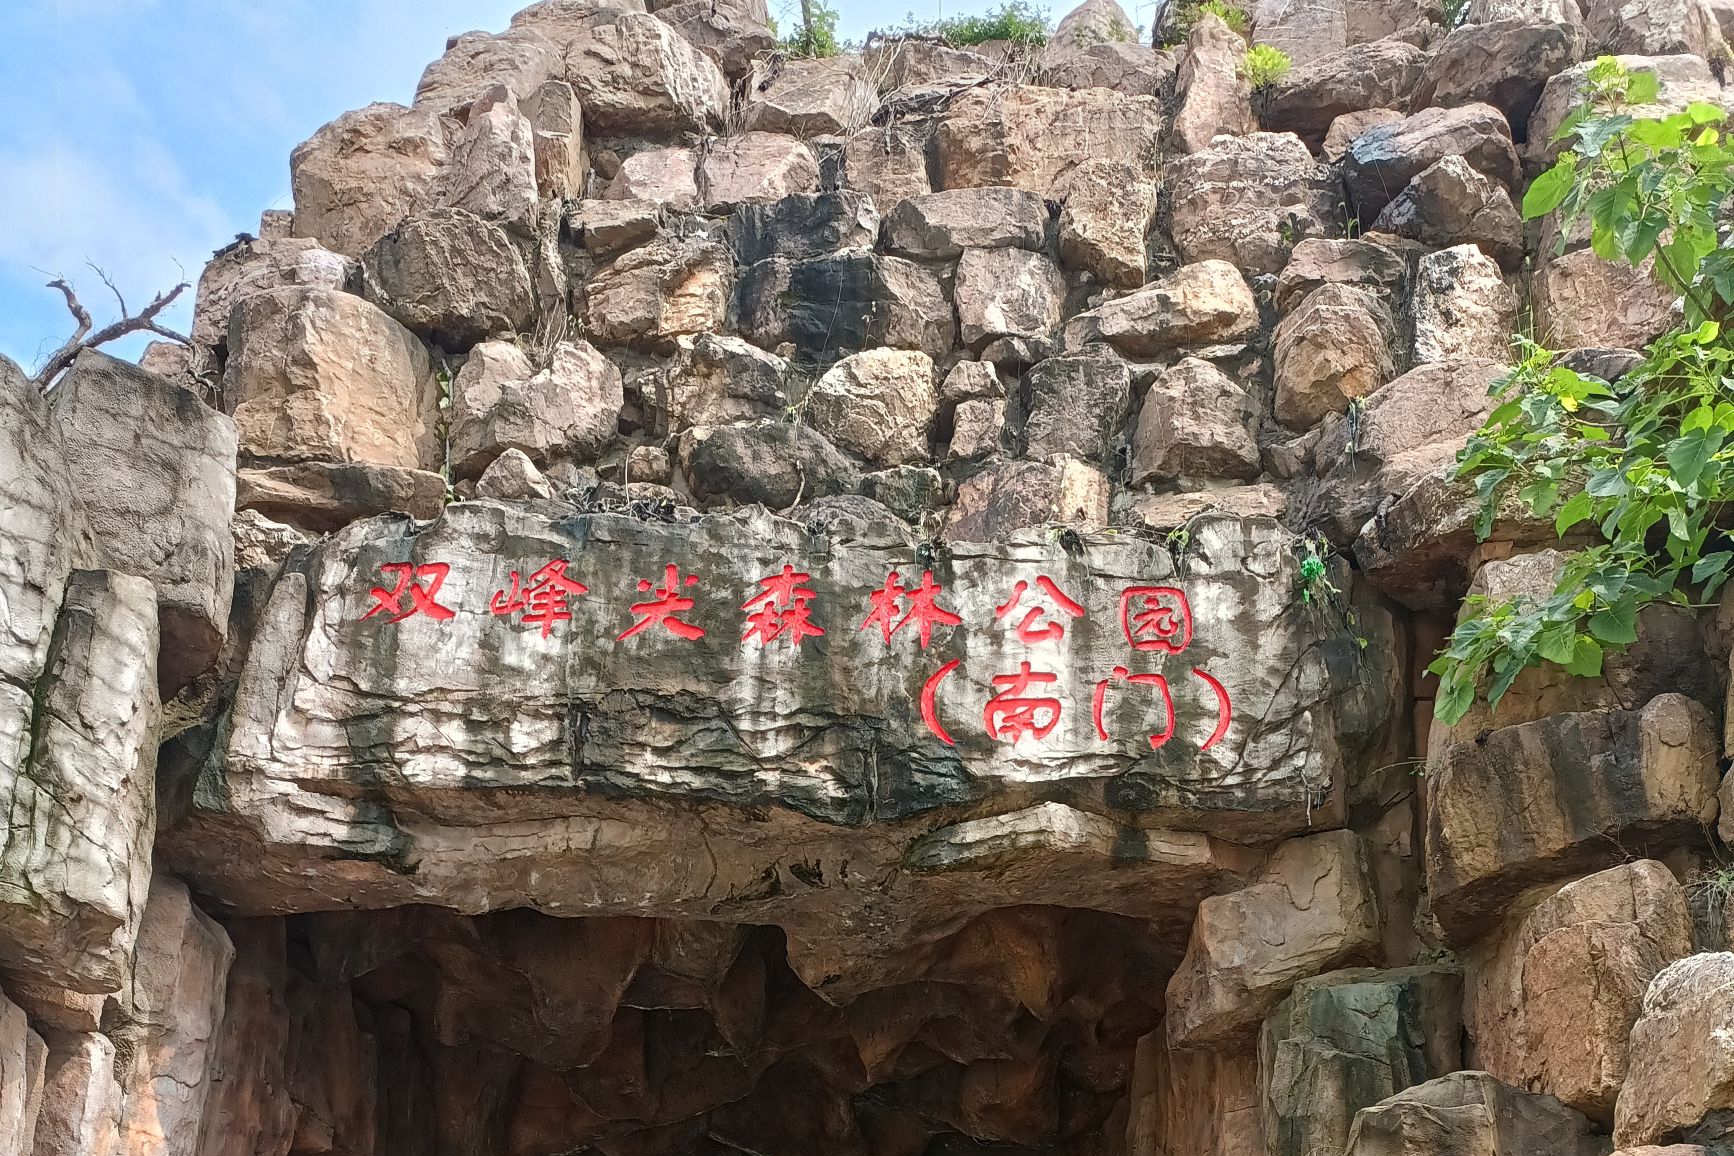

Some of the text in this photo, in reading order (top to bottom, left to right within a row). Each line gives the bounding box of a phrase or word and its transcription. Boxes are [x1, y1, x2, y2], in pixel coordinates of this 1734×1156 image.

[359, 557, 1194, 656] 双峰尖森林公园
